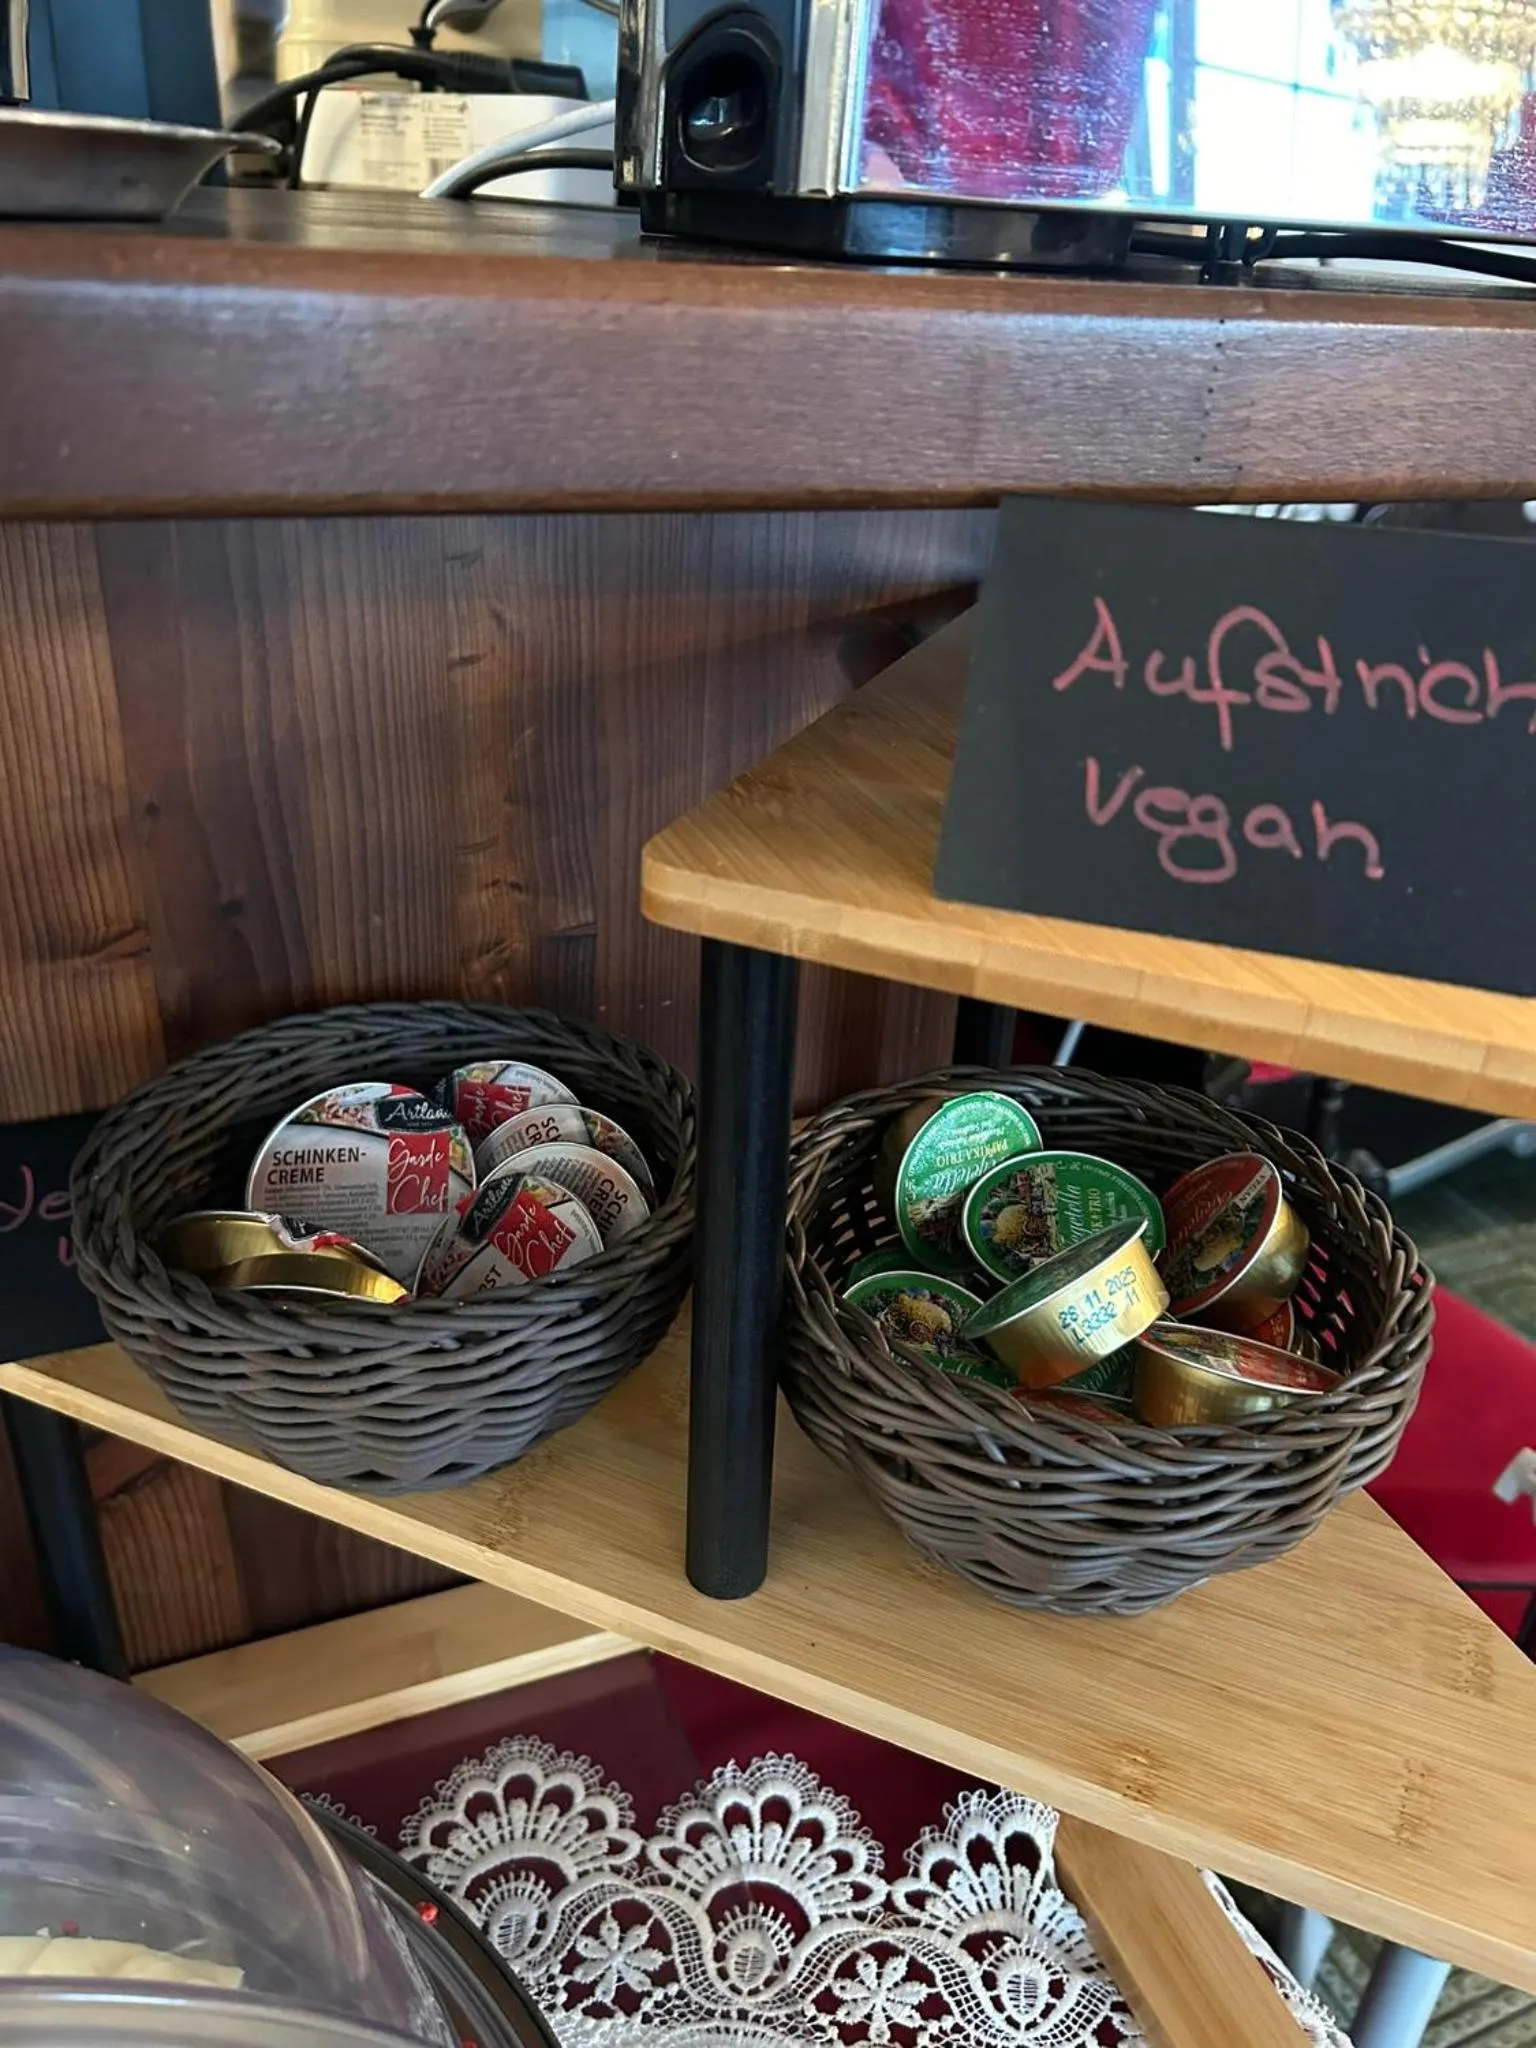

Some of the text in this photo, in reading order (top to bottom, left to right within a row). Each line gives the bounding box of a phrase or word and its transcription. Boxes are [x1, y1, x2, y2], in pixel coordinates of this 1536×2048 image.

[1052, 597, 1536, 752] Aufstrich
[272, 1147, 367, 1167] SCHINKEN-
[267, 1167, 326, 1185] CREME
[1238, 1174, 1267, 1204] VEGAN
[391, 1173, 449, 1215] Chef
[1105, 1265, 1137, 1297] 2025
